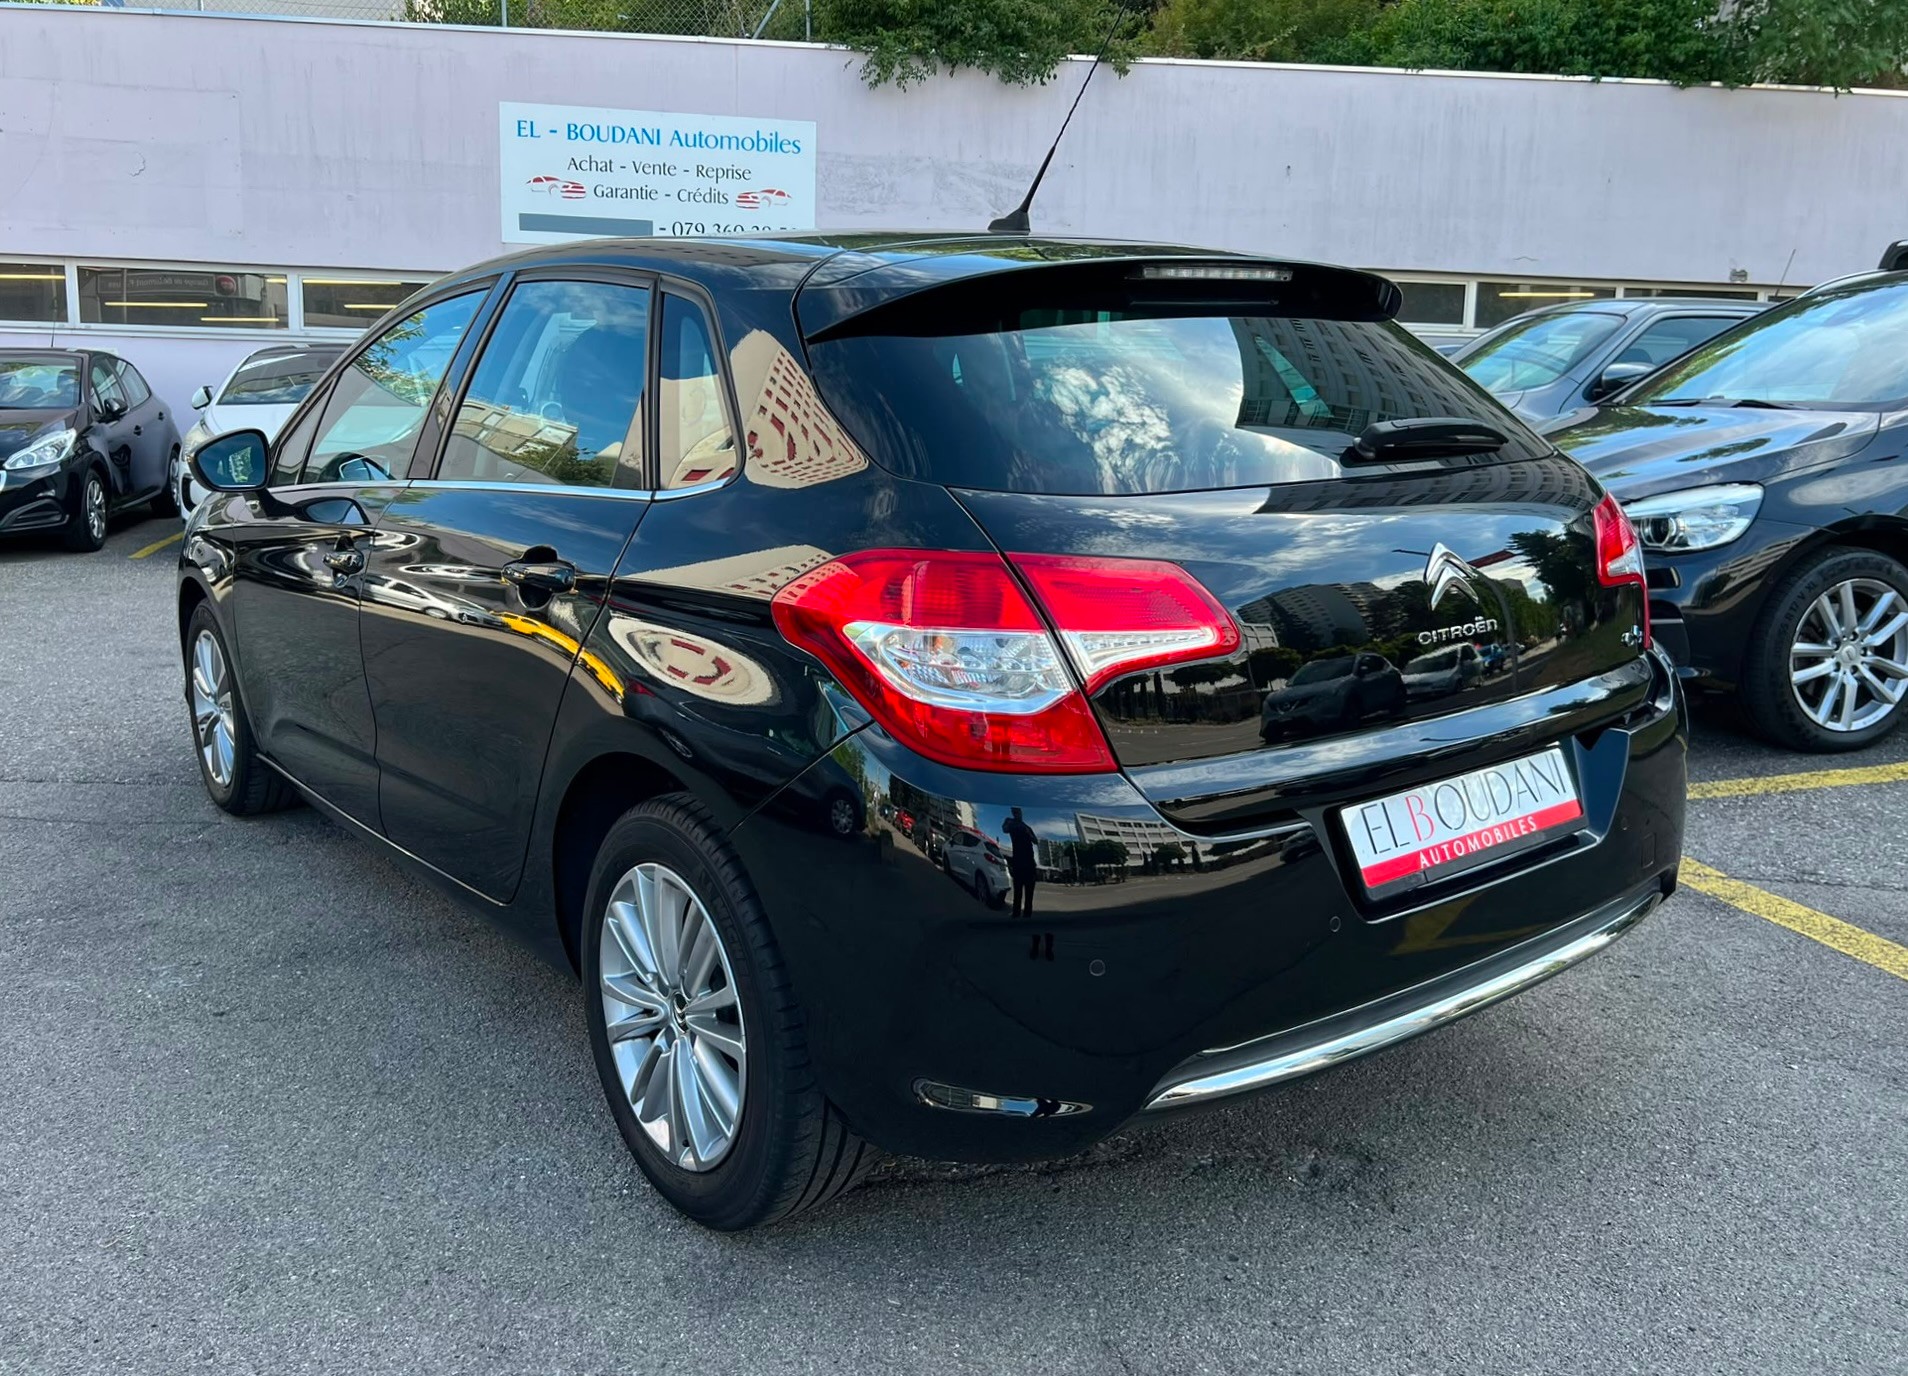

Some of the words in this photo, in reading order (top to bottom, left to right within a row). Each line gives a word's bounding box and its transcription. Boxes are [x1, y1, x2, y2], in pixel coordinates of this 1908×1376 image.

[517, 120, 541, 138] EL
[567, 123, 661, 146] BOUDANI
[669, 129, 801, 154] Automobiles
[567, 155, 614, 173] Achat
[632, 160, 677, 176] Vente
[696, 164, 752, 184] Reprise
[593, 184, 659, 201] Garantie
[677, 187, 729, 205] Crédits
[672, 221, 705, 237] 079
[1417, 615, 1498, 645] CITROËN
[1361, 801, 1410, 855] EL
[1405, 752, 1567, 842] BOUDANI
[1419, 816, 1537, 869] AUTOMOBILES
